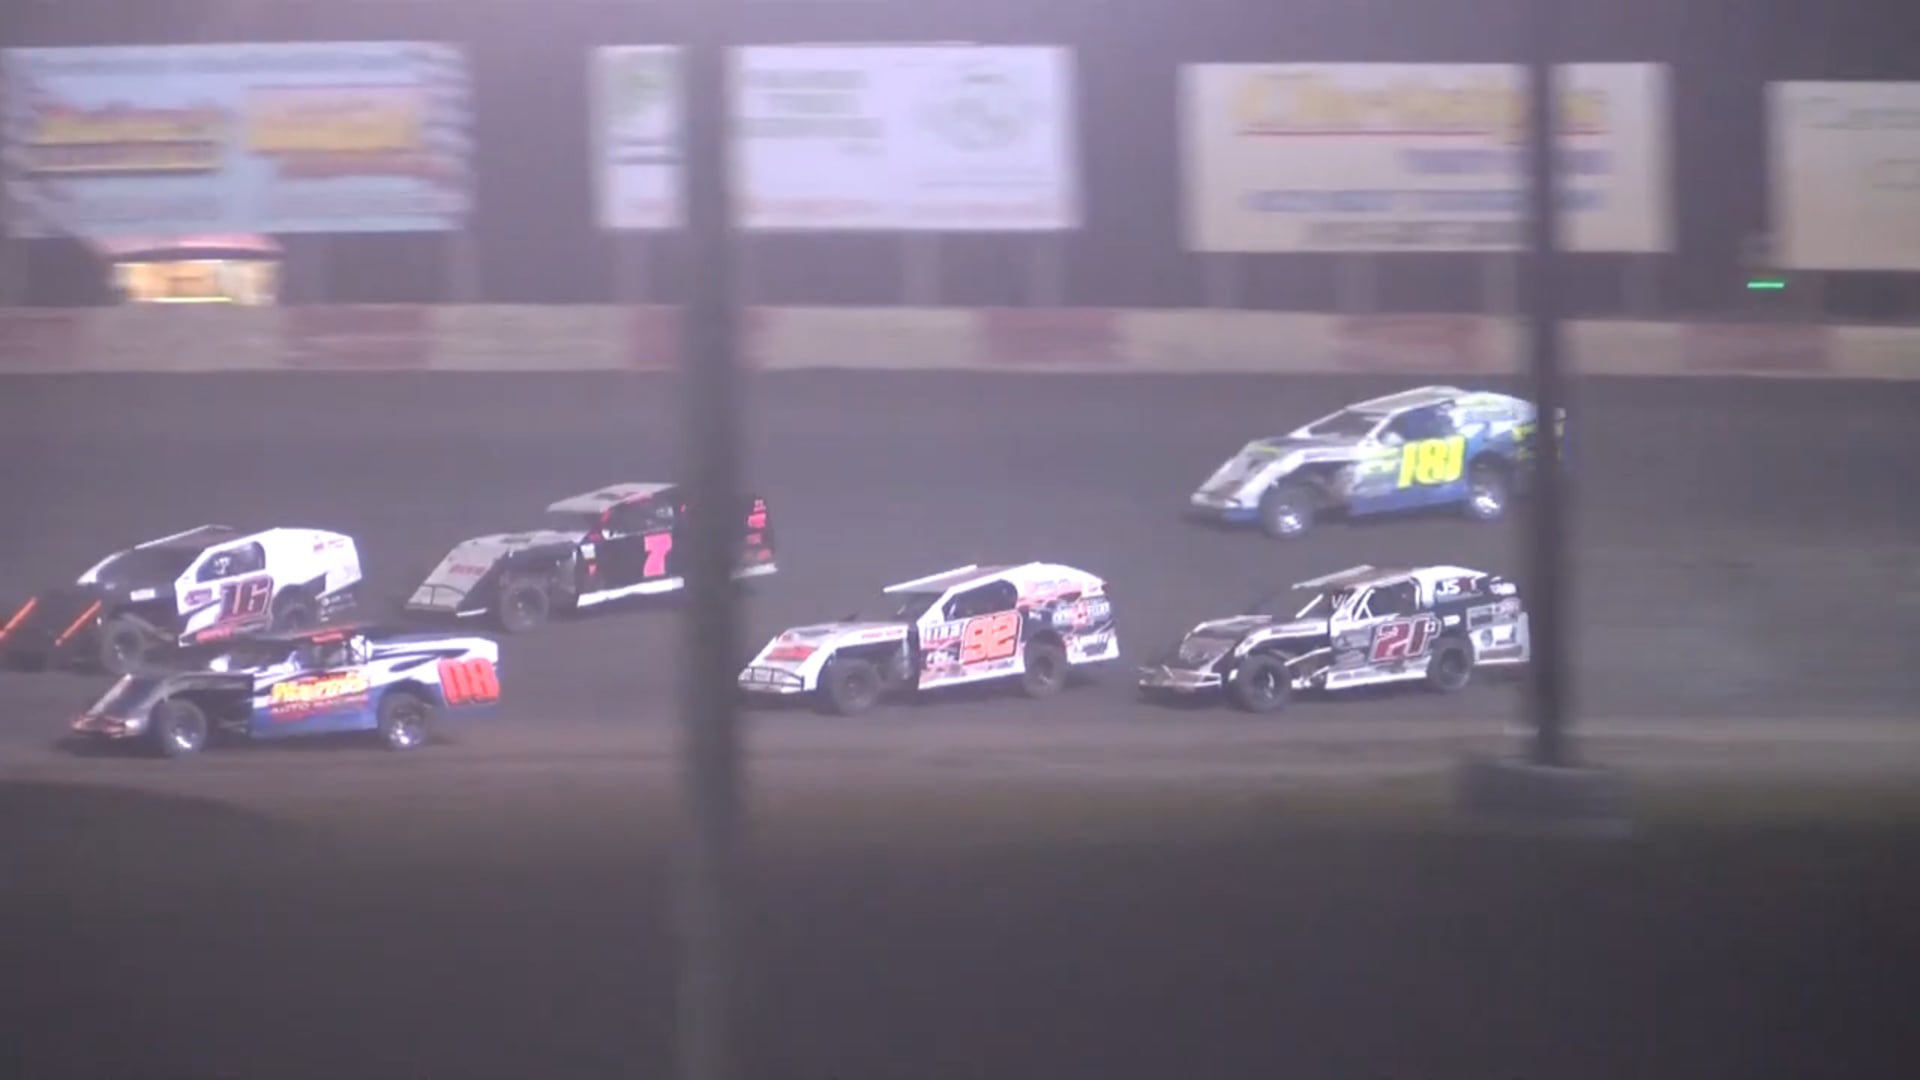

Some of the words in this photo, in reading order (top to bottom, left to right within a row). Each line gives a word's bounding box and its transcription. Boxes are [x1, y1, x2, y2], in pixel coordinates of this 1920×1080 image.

[1397, 434, 1466, 489] 181
[643, 532, 673, 577] 7
[217, 573, 274, 626] 16
[962, 611, 1022, 665] 92
[437, 657, 500, 704] 08
